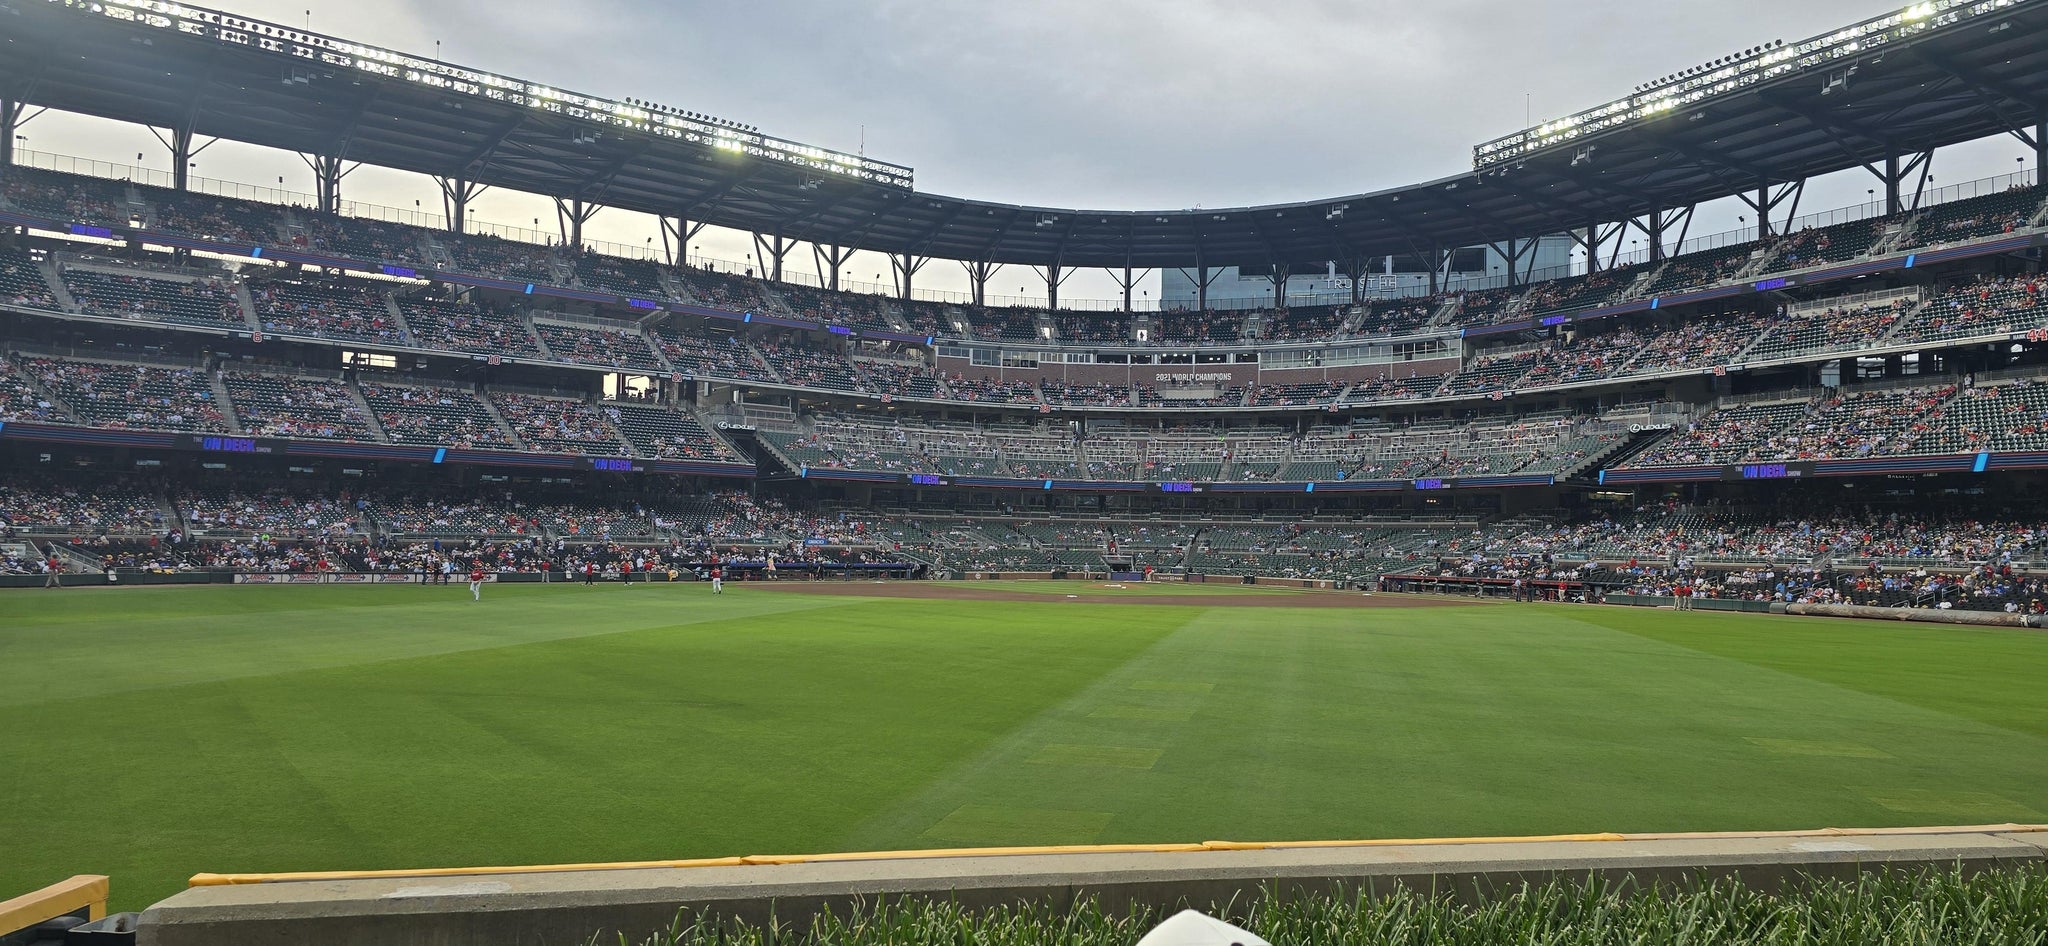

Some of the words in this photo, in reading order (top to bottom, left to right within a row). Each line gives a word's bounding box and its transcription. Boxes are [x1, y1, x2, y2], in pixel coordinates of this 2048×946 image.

[72, 224, 86, 235] ON
[87, 226, 111, 238] DECK
[384, 266, 394, 275] ON
[396, 268, 416, 278] DECK
[1327, 279, 1375, 289] TRUST
[1756, 282, 1766, 291] ON
[1767, 278, 1786, 290] DECK
[630, 299, 640, 308] ON
[640, 300, 656, 309] DECK
[1543, 317, 1551, 326] ON
[1551, 315, 1565, 324] DECK
[830, 326, 837, 334] ON
[838, 326, 850, 335] DECK
[2026, 328, 2048, 342] 44
[253, 331, 262, 342] 6
[488, 355, 500, 365] 10
[1713, 364, 1726, 376] 41
[1172, 373, 1194, 381] WORLD
[1195, 373, 1231, 381] CHAMPIONS
[203, 437, 221, 450] ON
[223, 438, 255, 452] DECK
[594, 459, 608, 470] ON
[609, 459, 632, 471] DECK
[1743, 466, 1758, 478] ON
[1759, 464, 1787, 477] DECK
[912, 475, 922, 484] ON
[922, 475, 939, 485] DECK
[1415, 479, 1424, 489] ON
[1425, 479, 1441, 489] DECK
[1162, 482, 1173, 491] ON
[1173, 483, 1193, 492] DECK
